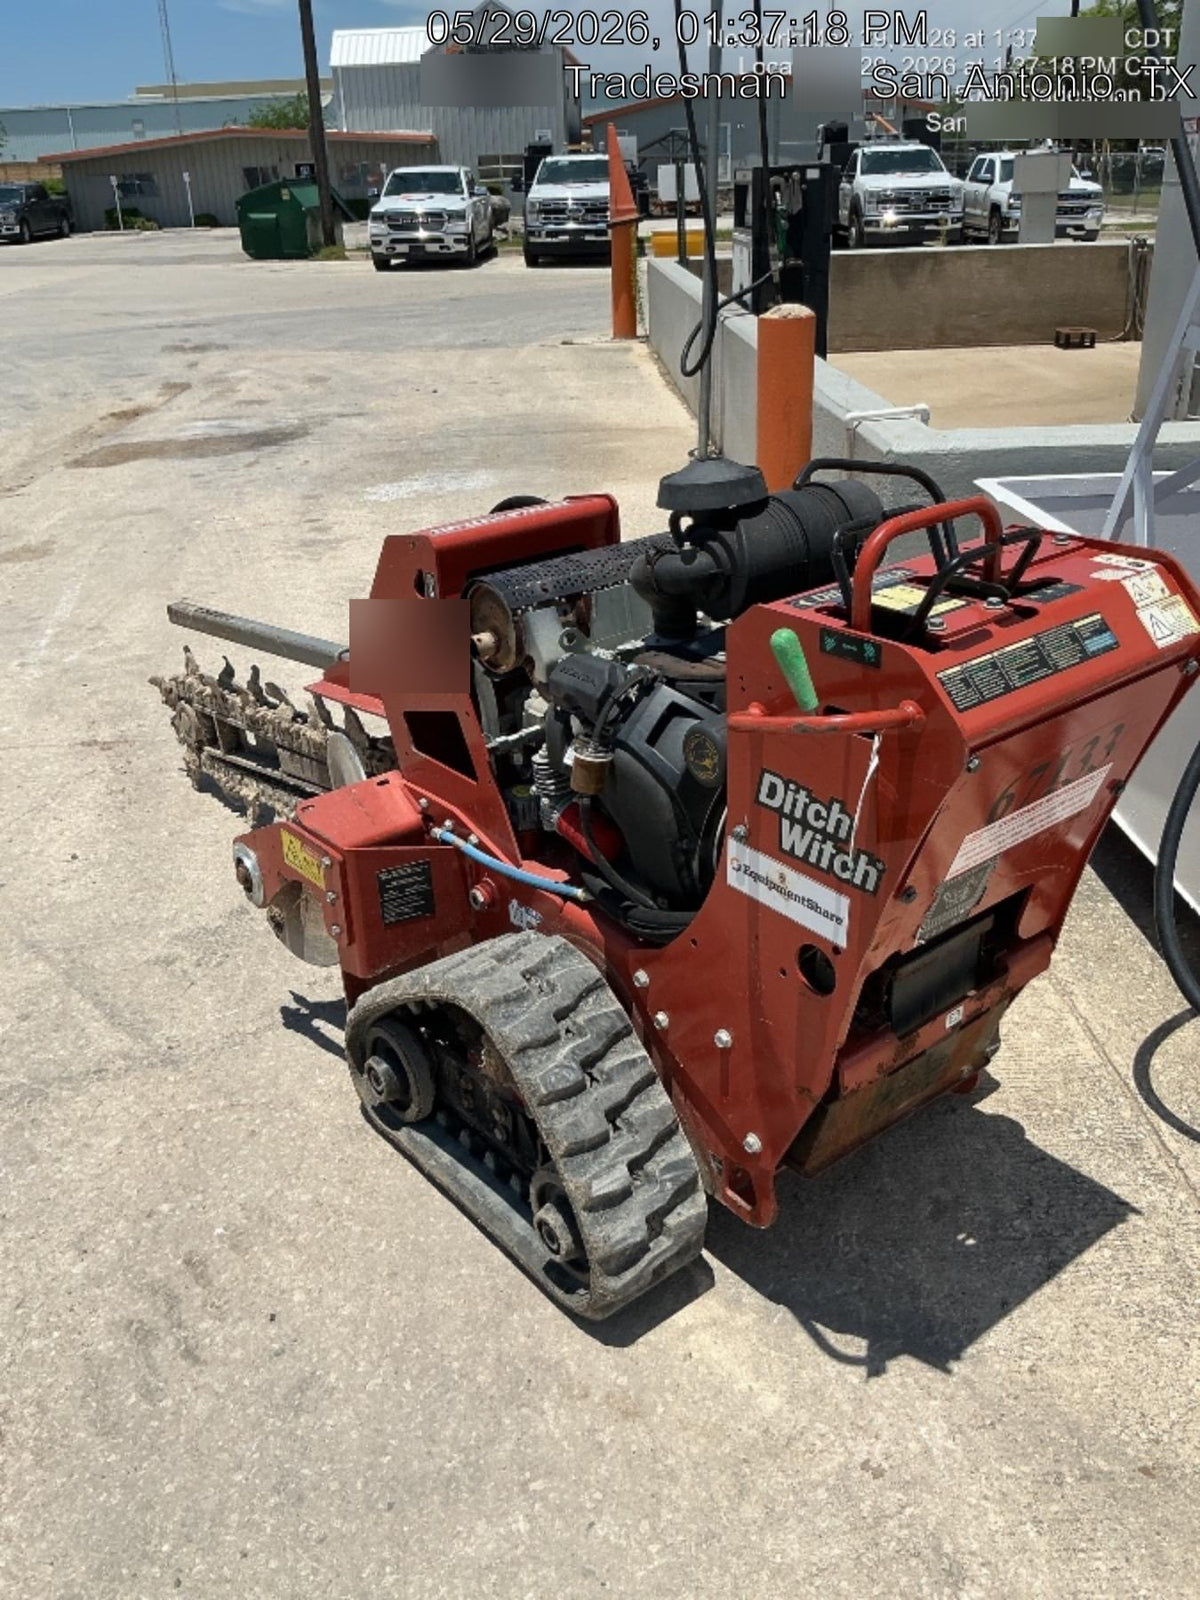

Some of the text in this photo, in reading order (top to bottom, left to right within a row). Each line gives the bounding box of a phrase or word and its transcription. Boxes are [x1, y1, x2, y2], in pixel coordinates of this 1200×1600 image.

[756, 769, 852, 840] Ditch
[779, 816, 881, 893] Witch
[742, 862, 844, 926] EquipmentShare
